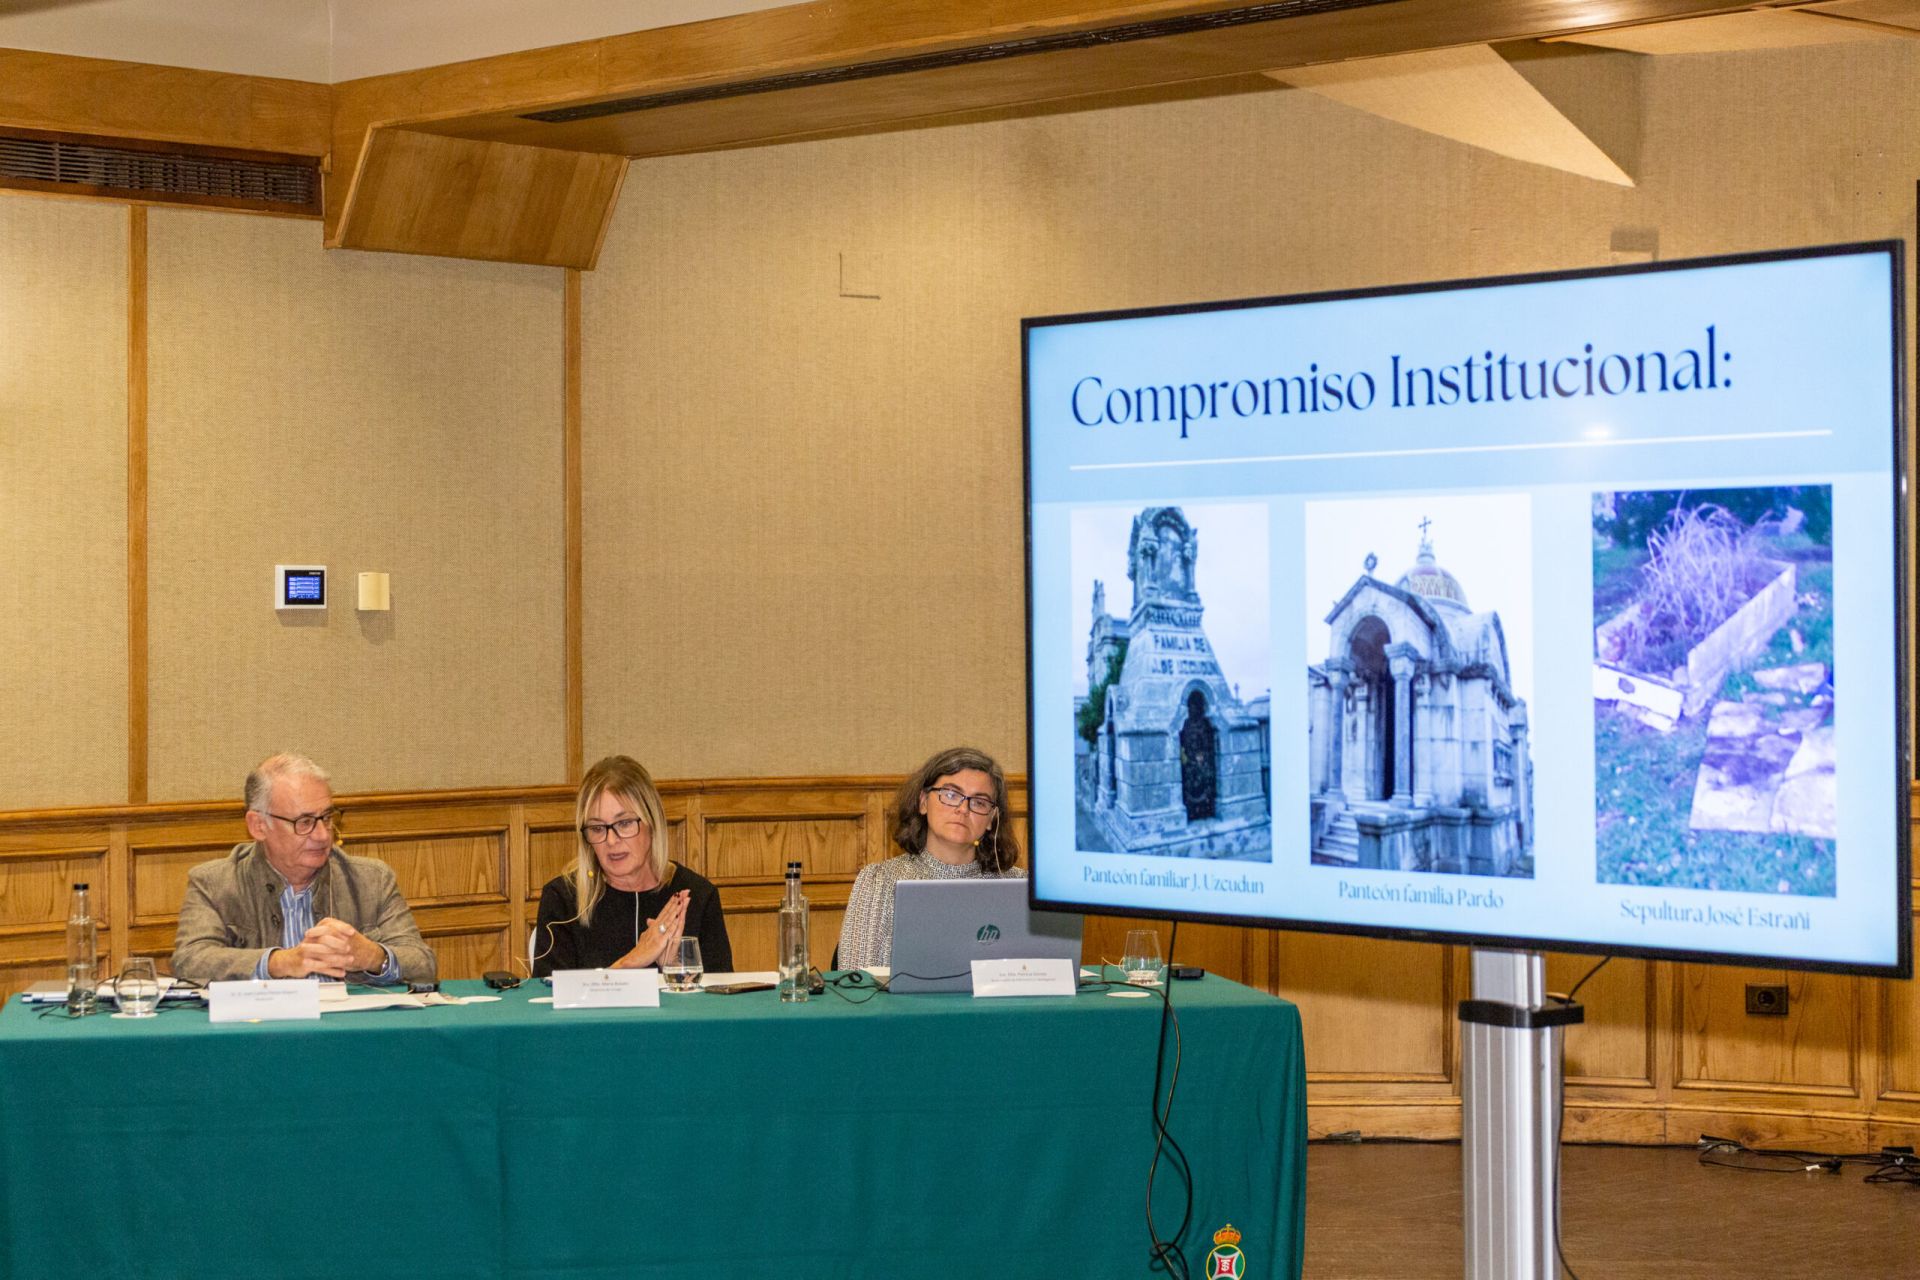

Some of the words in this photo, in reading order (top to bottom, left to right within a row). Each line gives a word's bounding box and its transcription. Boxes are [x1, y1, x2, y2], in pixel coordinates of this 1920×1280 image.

[1070, 362, 1375, 438] Compromiso
[1391, 324, 1732, 408] Institucional:
[1083, 866, 1137, 886] Panteón
[1140, 868, 1190, 889] familiar
[1203, 872, 1264, 895] Uzcudun
[1339, 880, 1400, 902] Panteón
[1403, 883, 1453, 906] familia
[1457, 888, 1504, 909] Pardo
[1620, 900, 1703, 925] Sepultura
[1704, 904, 1744, 926] José
[1748, 907, 1810, 931] Estrañi
